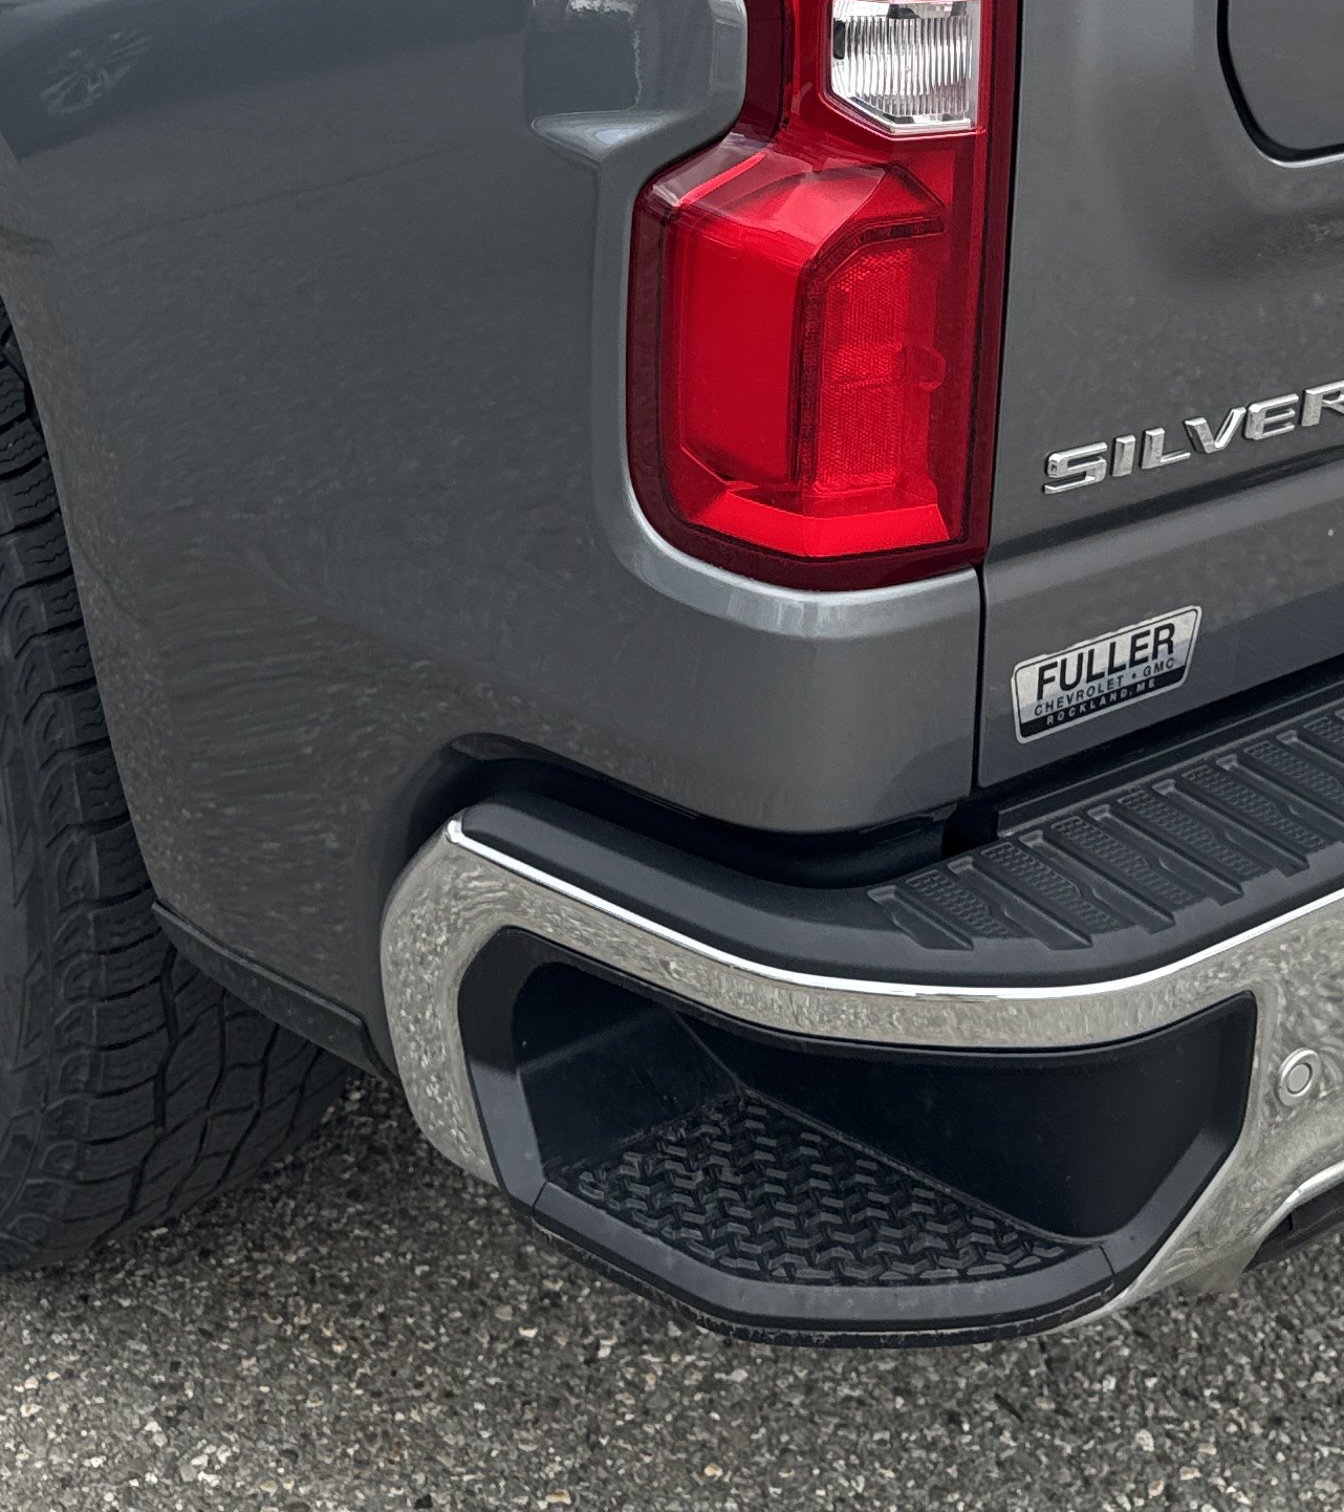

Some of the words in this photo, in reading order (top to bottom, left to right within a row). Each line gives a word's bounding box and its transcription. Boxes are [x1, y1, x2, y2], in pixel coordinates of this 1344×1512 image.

[1034, 675, 1125, 717] CHEVROLET
[1143, 657, 1175, 676] GMC
[1037, 623, 1175, 700] FULLER
[1136, 678, 1156, 693] ME
